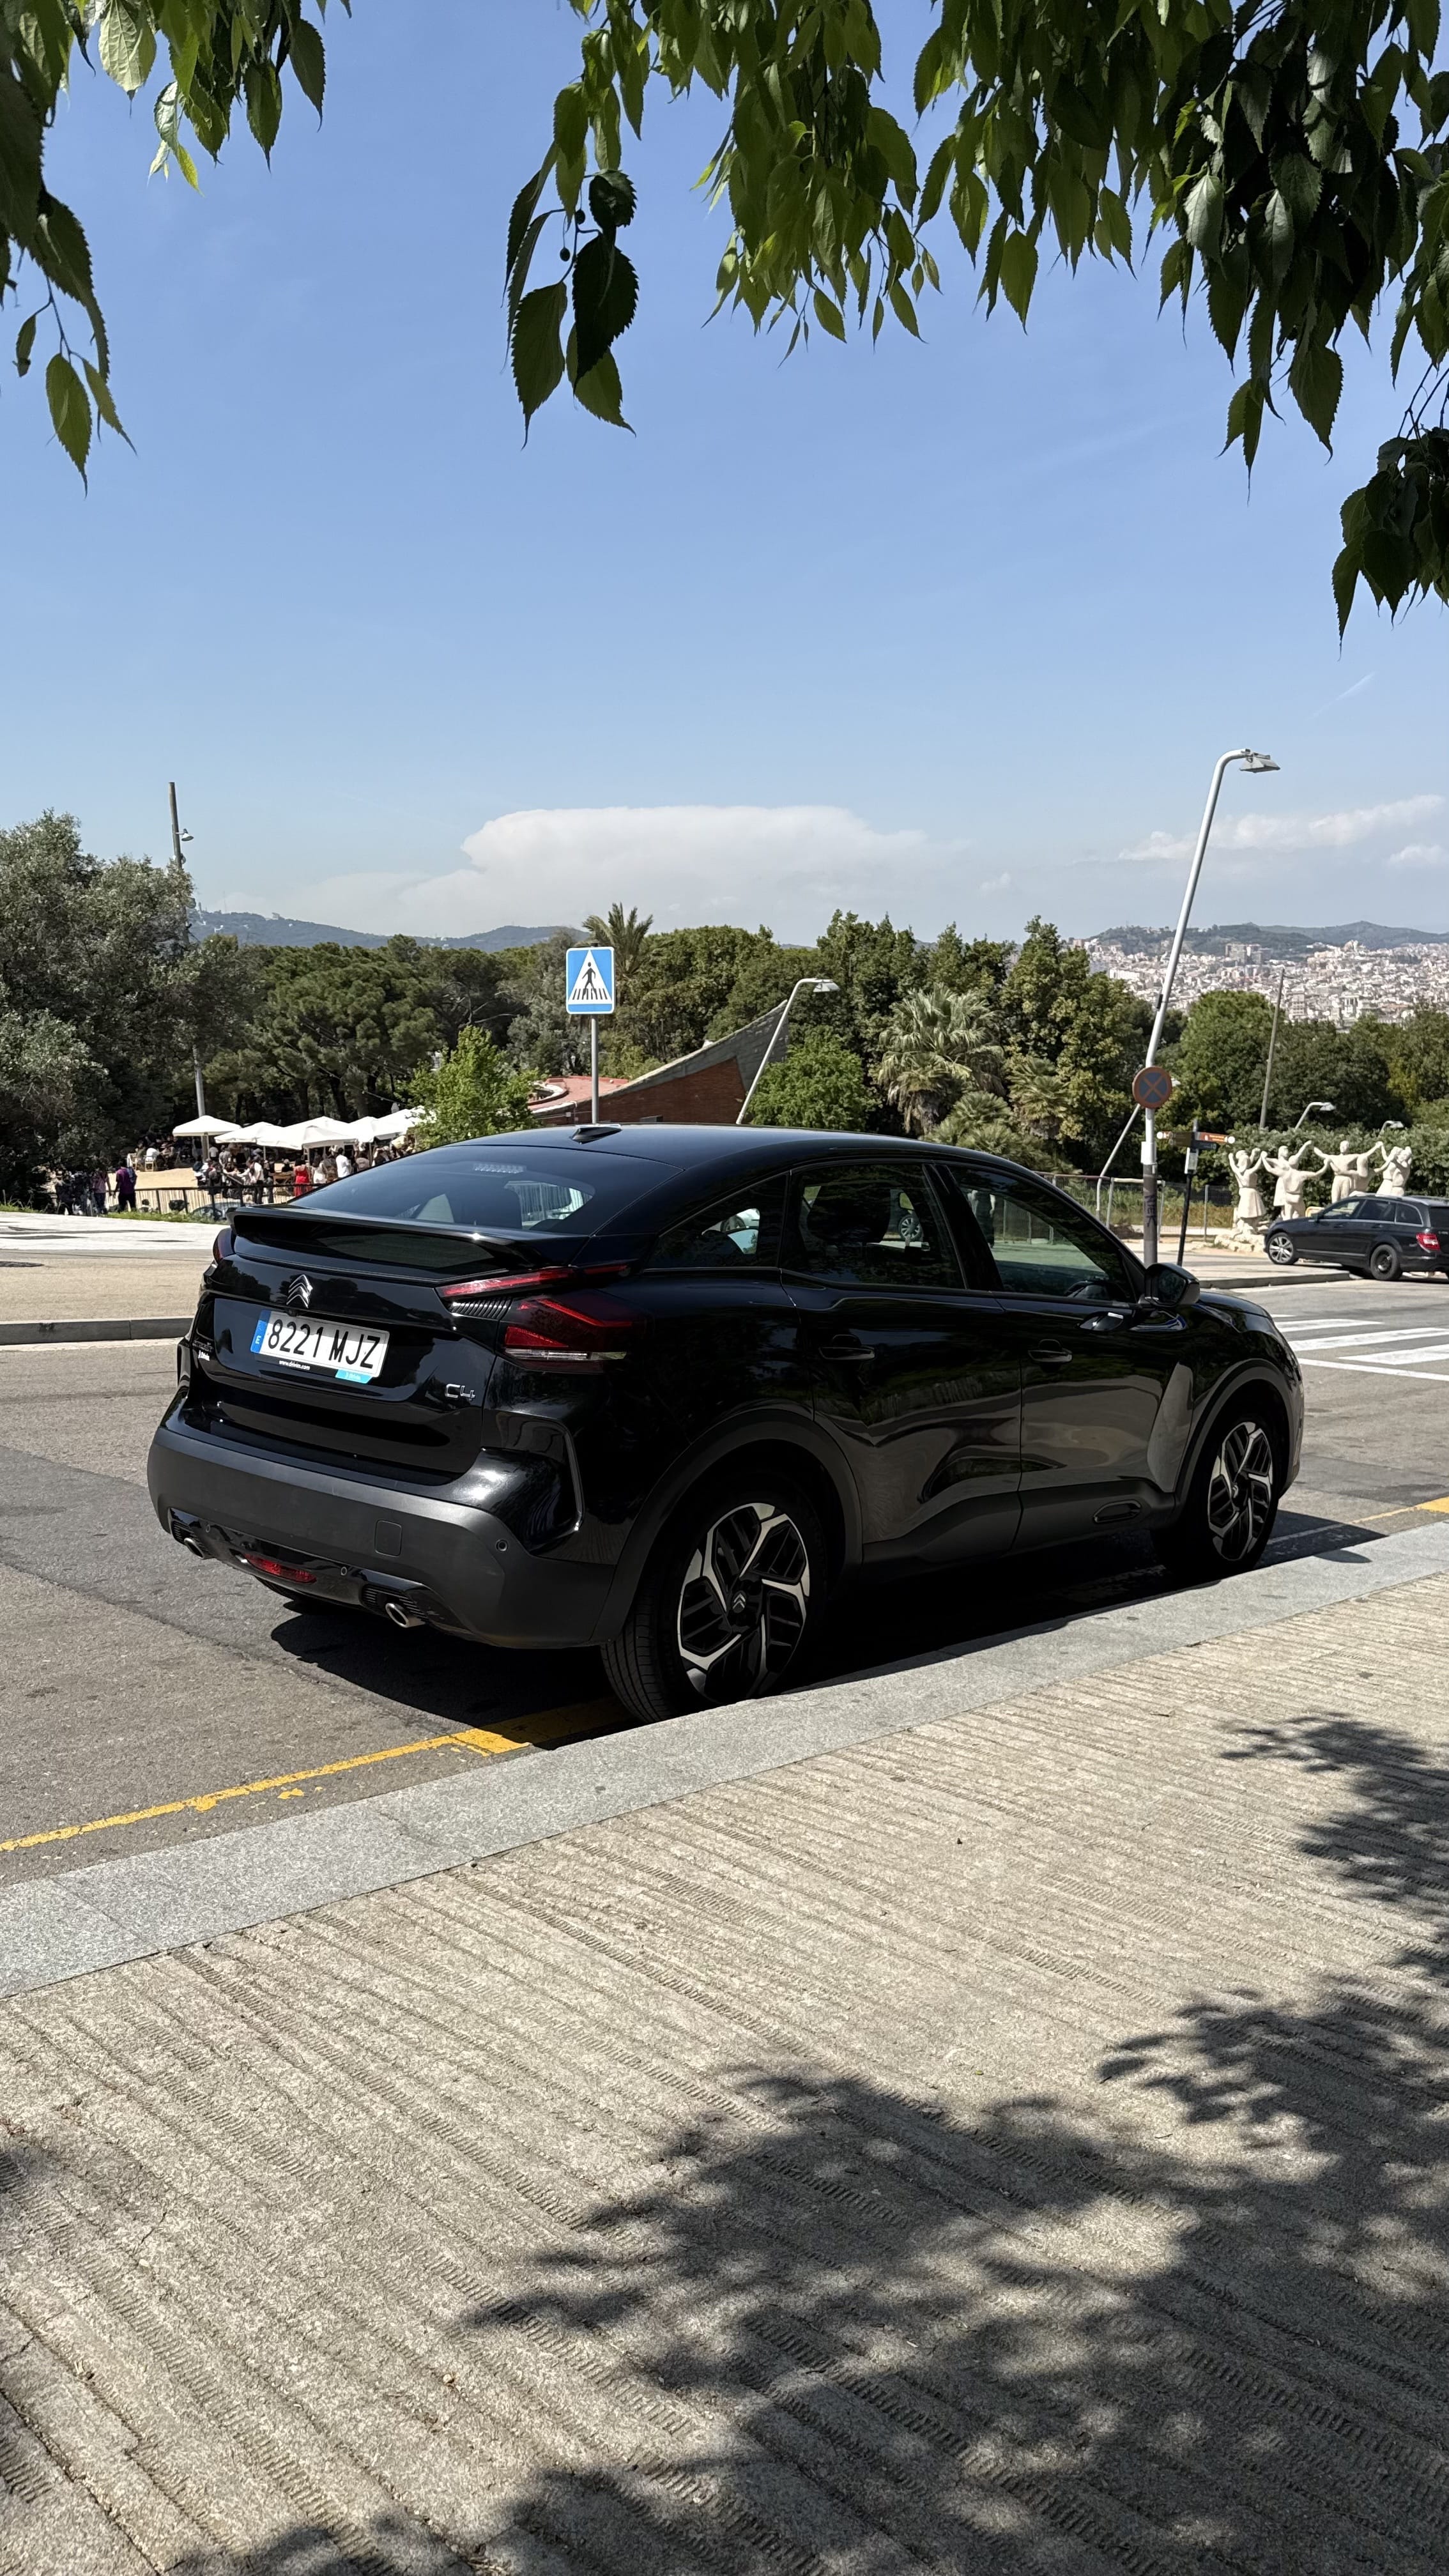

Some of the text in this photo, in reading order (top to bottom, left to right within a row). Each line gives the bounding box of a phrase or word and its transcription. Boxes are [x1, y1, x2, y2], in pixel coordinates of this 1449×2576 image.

[255, 1335, 261, 1345] E
[268, 1319, 381, 1369] 8221 MJZ
[445, 1383, 475, 1400] C4
